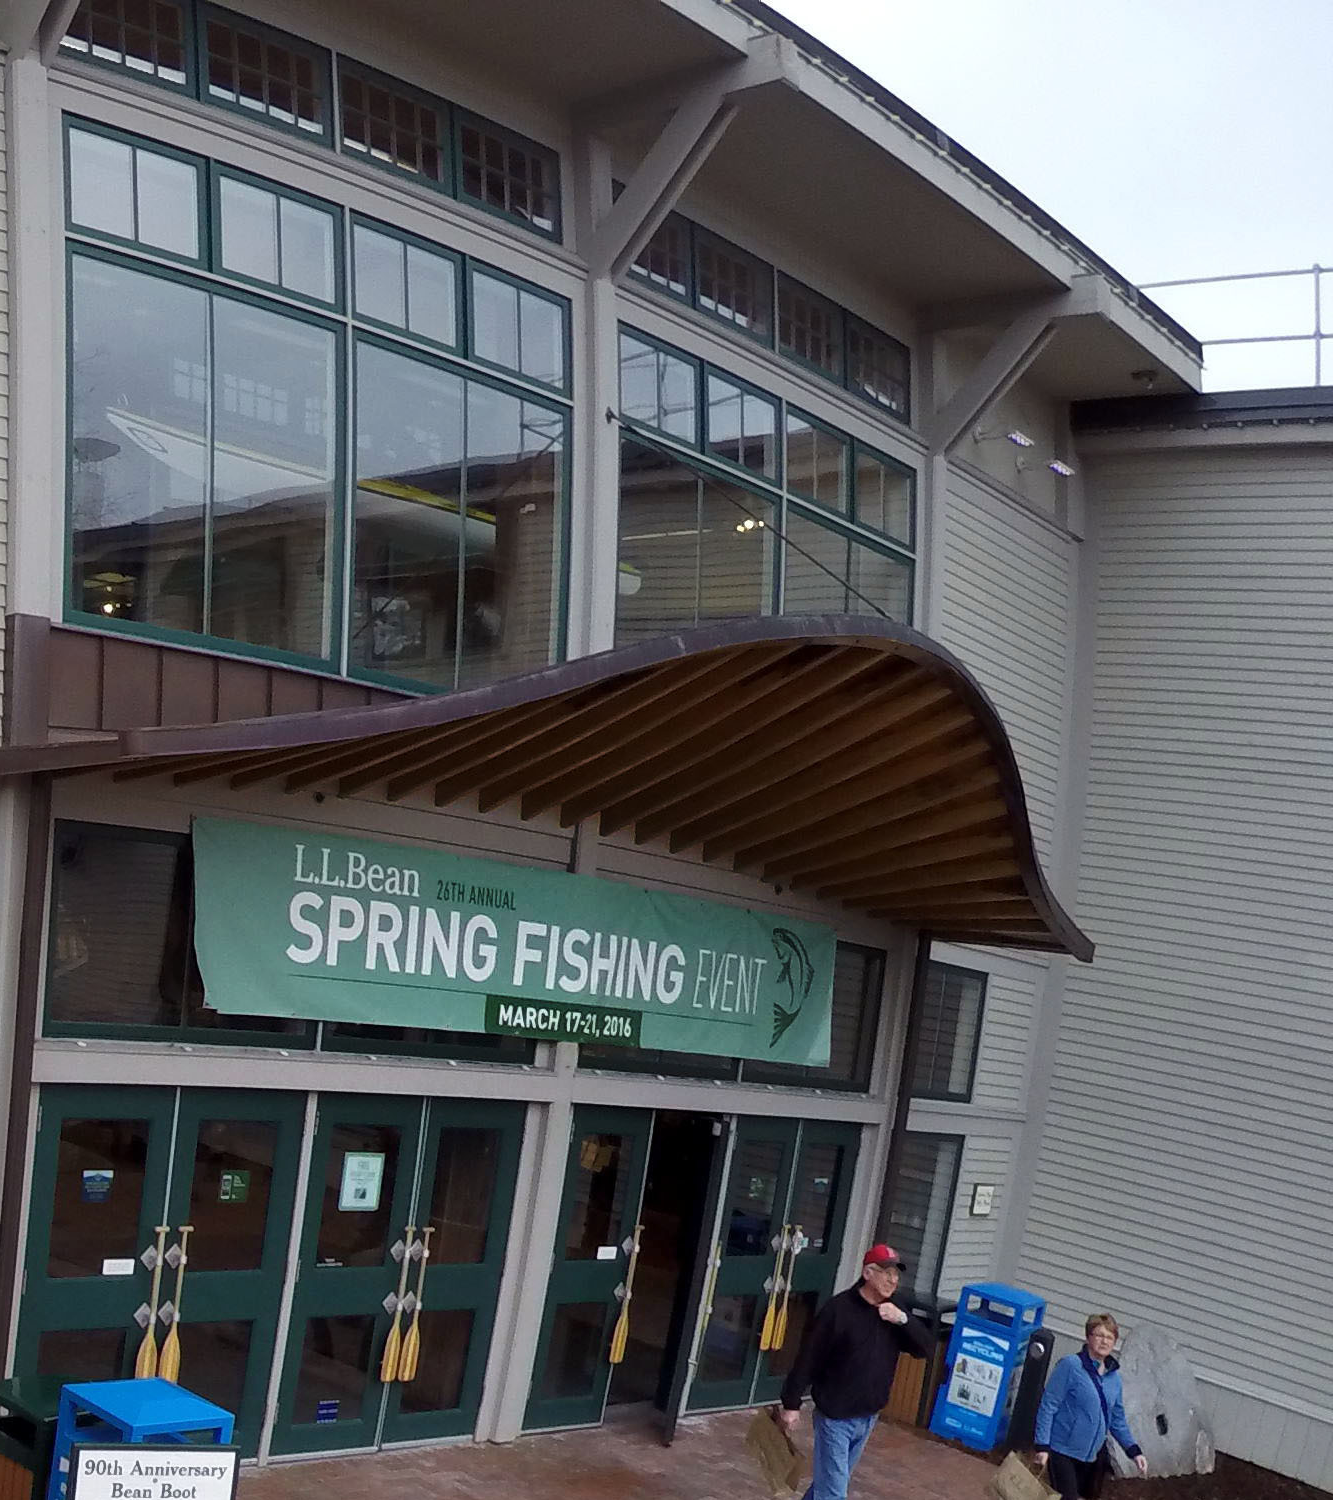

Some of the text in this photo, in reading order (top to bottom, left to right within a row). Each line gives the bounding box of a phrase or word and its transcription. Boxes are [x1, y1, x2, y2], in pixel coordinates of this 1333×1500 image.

[294, 844, 420, 897] L.L.Bean
[437, 880, 517, 911] 26TH ANNUAL
[285, 891, 768, 1016] SPRING FISHING EVENT
[498, 1004, 633, 1038] MARCH 17-21, 2016
[84, 1459, 228, 1480] 90th Anniversary
[111, 1483, 196, 1499] Bean Boot
